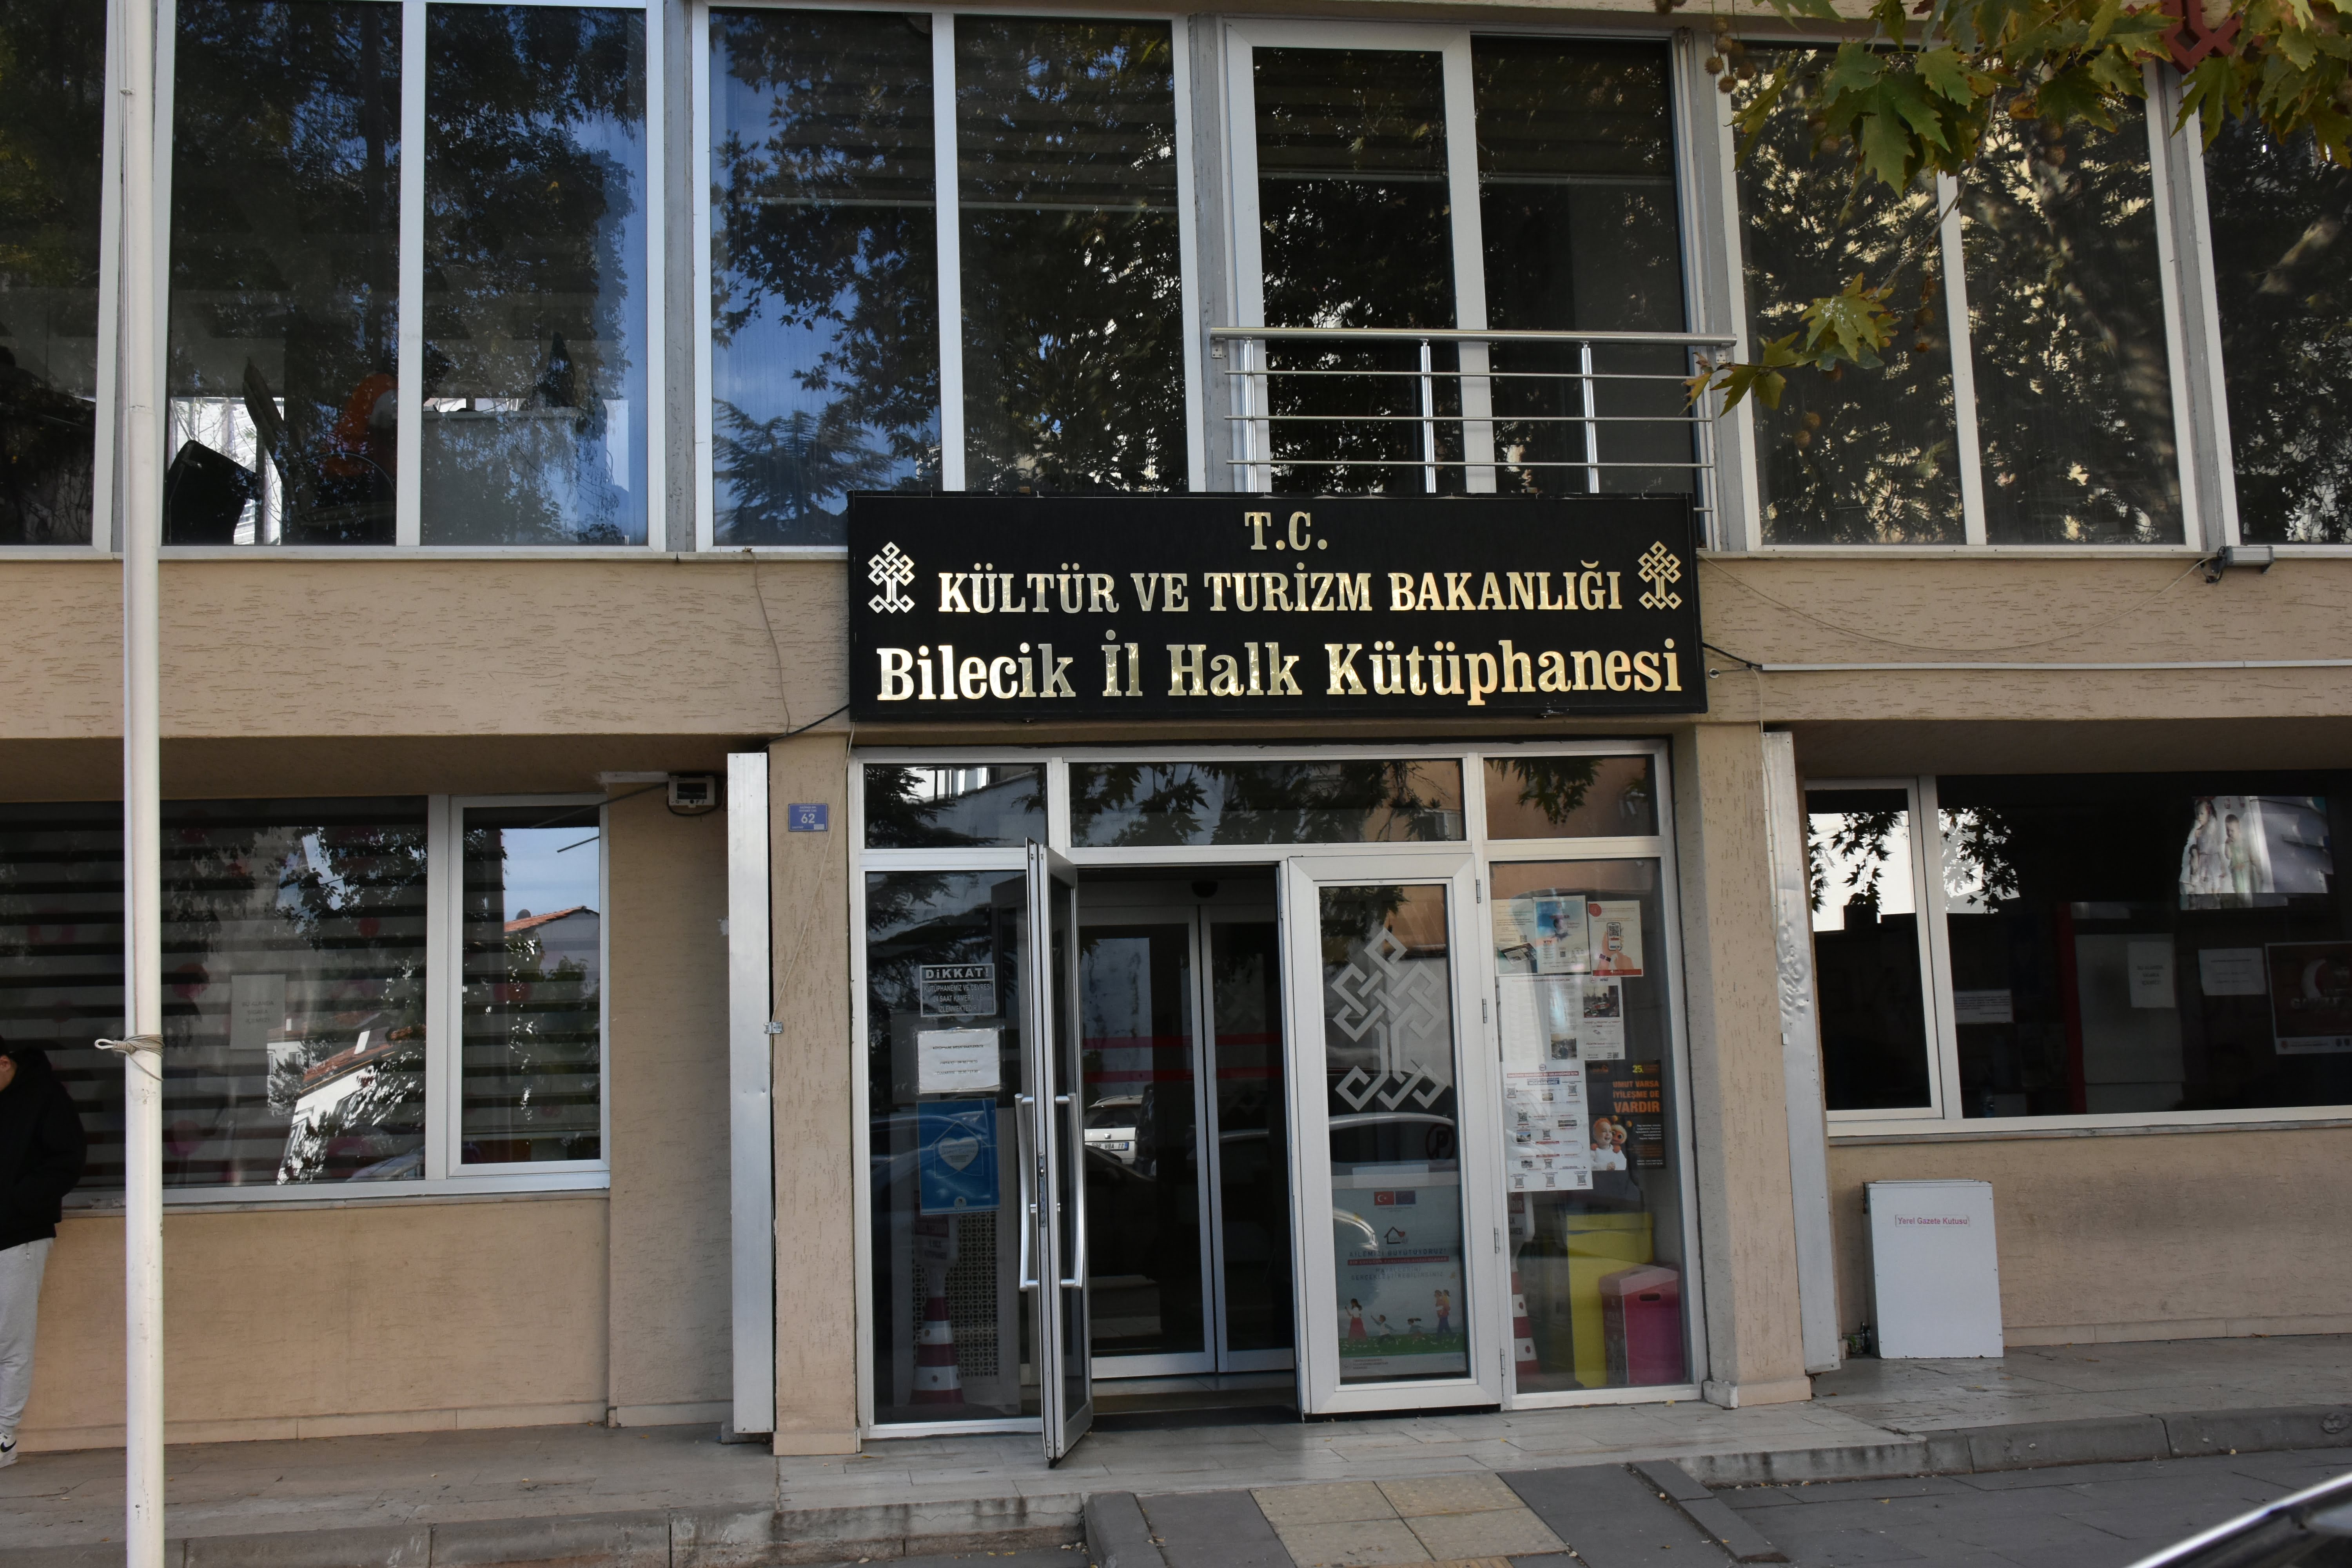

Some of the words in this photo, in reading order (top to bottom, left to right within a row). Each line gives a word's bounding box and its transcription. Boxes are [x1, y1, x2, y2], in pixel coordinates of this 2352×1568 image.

[1244, 511, 1328, 551] T.C.
[938, 563, 1119, 613] KÜLTÜR
[1131, 573, 1189, 612] VE
[1204, 562, 1373, 612] TURİZM
[1390, 560, 1623, 611] BAKANLIĞI
[877, 642, 1076, 701] Bilecik
[1102, 629, 1143, 697] İl
[1166, 642, 1303, 696] Halk
[1325, 637, 1682, 705] Kütüphanesi
[801, 813, 815, 824] 62
[924, 983, 962, 992] KÜTÜPHANEMİZ
[1613, 1090, 1648, 1099] İYİLEŞME
[1613, 1101, 1661, 1113] VARDIR
